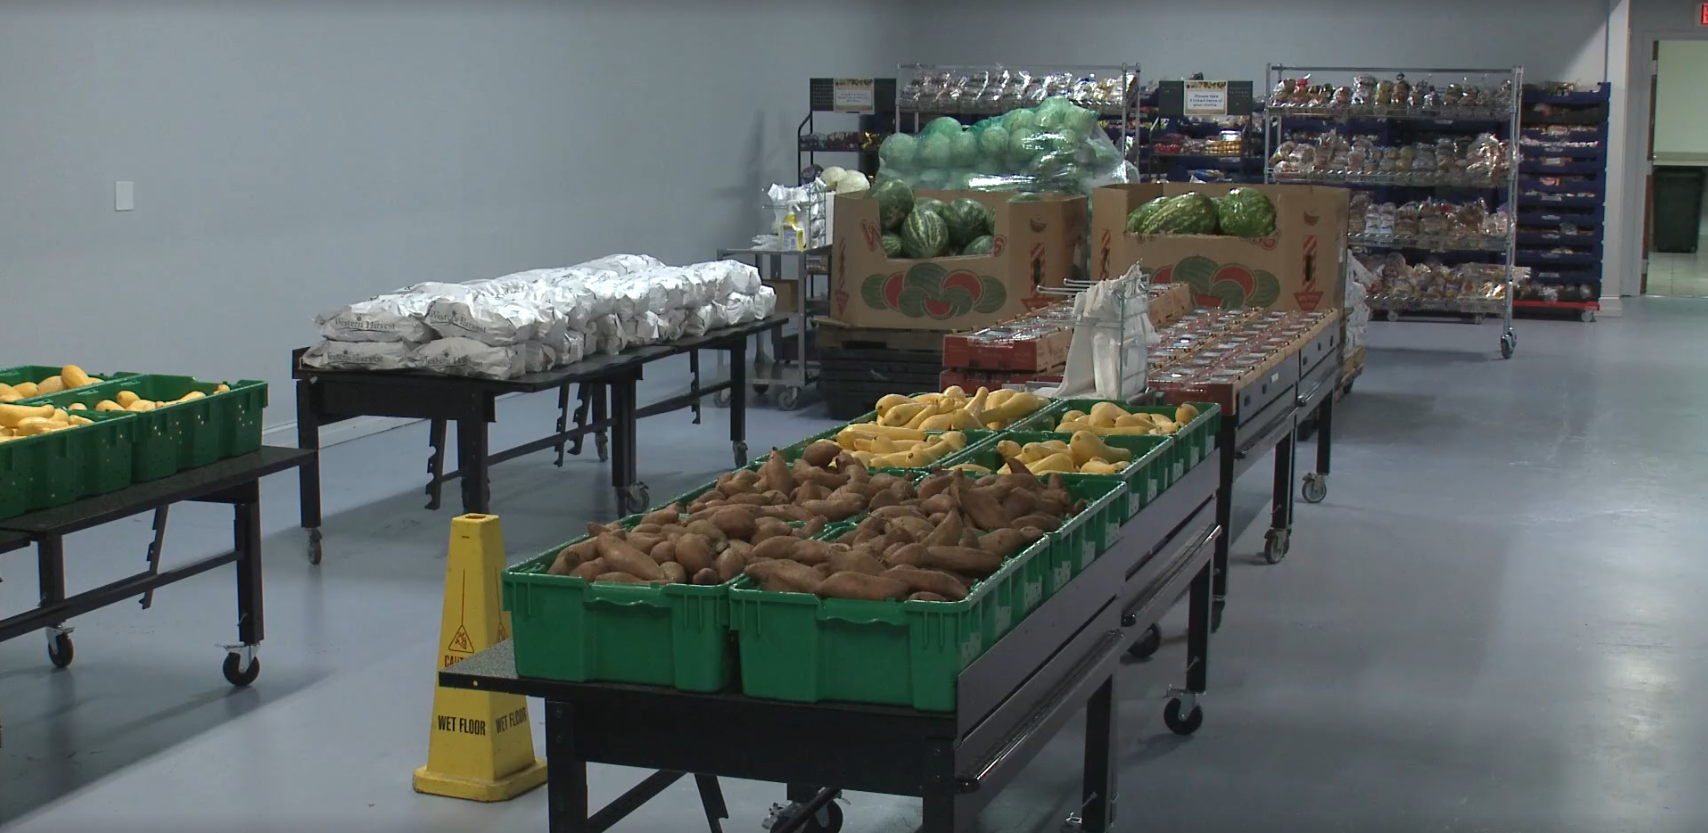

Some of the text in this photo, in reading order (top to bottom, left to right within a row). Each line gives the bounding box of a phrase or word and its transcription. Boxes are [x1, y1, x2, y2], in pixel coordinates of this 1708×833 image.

[335, 318, 396, 330] Western Harvest
[438, 714, 487, 736] WET FLOOR
[495, 706, 527, 734] WET FLOOR
